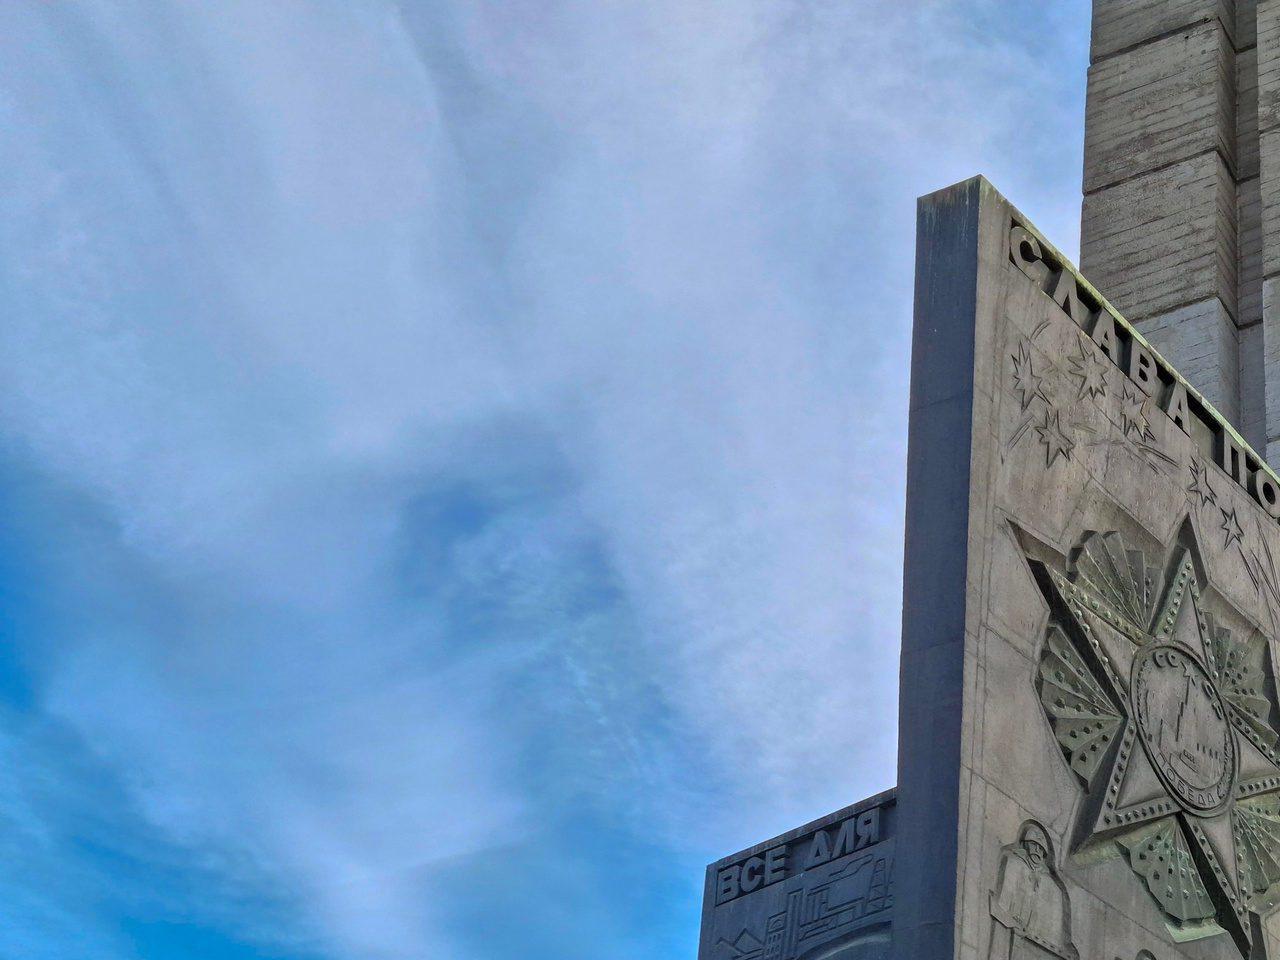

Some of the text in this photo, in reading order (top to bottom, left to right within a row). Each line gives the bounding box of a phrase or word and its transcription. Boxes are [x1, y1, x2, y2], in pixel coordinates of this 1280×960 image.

[1010, 226, 1192, 440] СЛАВА
[1156, 752, 1216, 806] ПОБЕДА
[716, 807, 881, 904] ВСЕ ДЛЯ
